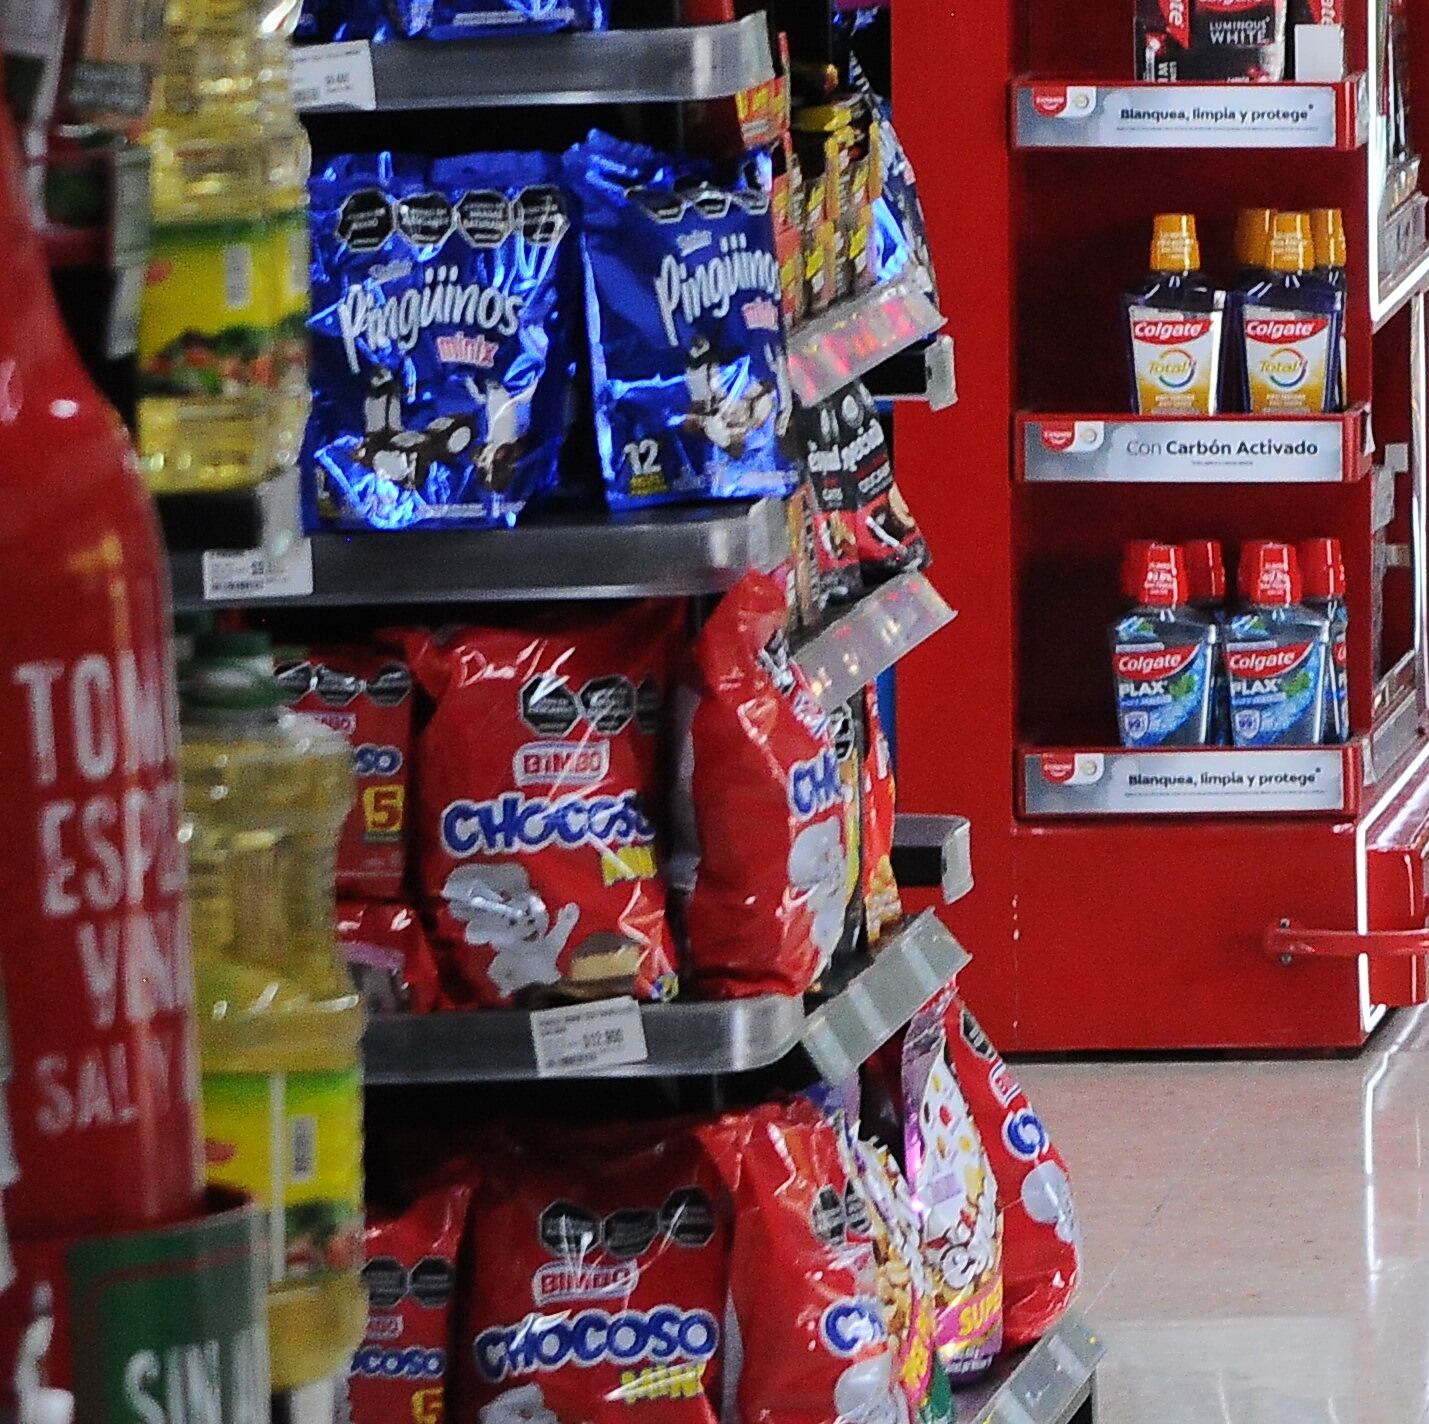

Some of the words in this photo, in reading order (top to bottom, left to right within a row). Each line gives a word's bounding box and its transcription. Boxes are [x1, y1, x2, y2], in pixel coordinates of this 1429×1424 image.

[1208, 20, 1267, 33] LUMINOUS
[1210, 30, 1267, 45] WHITE
[1120, 108, 1190, 123] Blanquea,
[1192, 107, 1236, 123] limpia
[1239, 109, 1249, 124] y
[339, 264, 524, 374] Pingüinos
[1135, 321, 1203, 340] Colgate
[1246, 321, 1315, 340] Colgate
[1149, 360, 1187, 375] Total
[1259, 360, 1297, 375] Total
[1126, 440, 1162, 456] Con
[1165, 437, 1232, 457] Carbón
[1235, 437, 1319, 457] Activado
[624, 440, 663, 476] 12
[1118, 651, 1182, 675] Colgate
[1230, 650, 1296, 674] Colgate
[1118, 679, 1165, 698] PLAX
[1230, 677, 1278, 697] PLAX
[523, 752, 602, 775] BIMBO
[1128, 773, 1198, 788] Blanquea,
[1200, 771, 1244, 788] limpia
[1248, 775, 1257, 788] y
[475, 1305, 720, 1382] CHOCOSO
